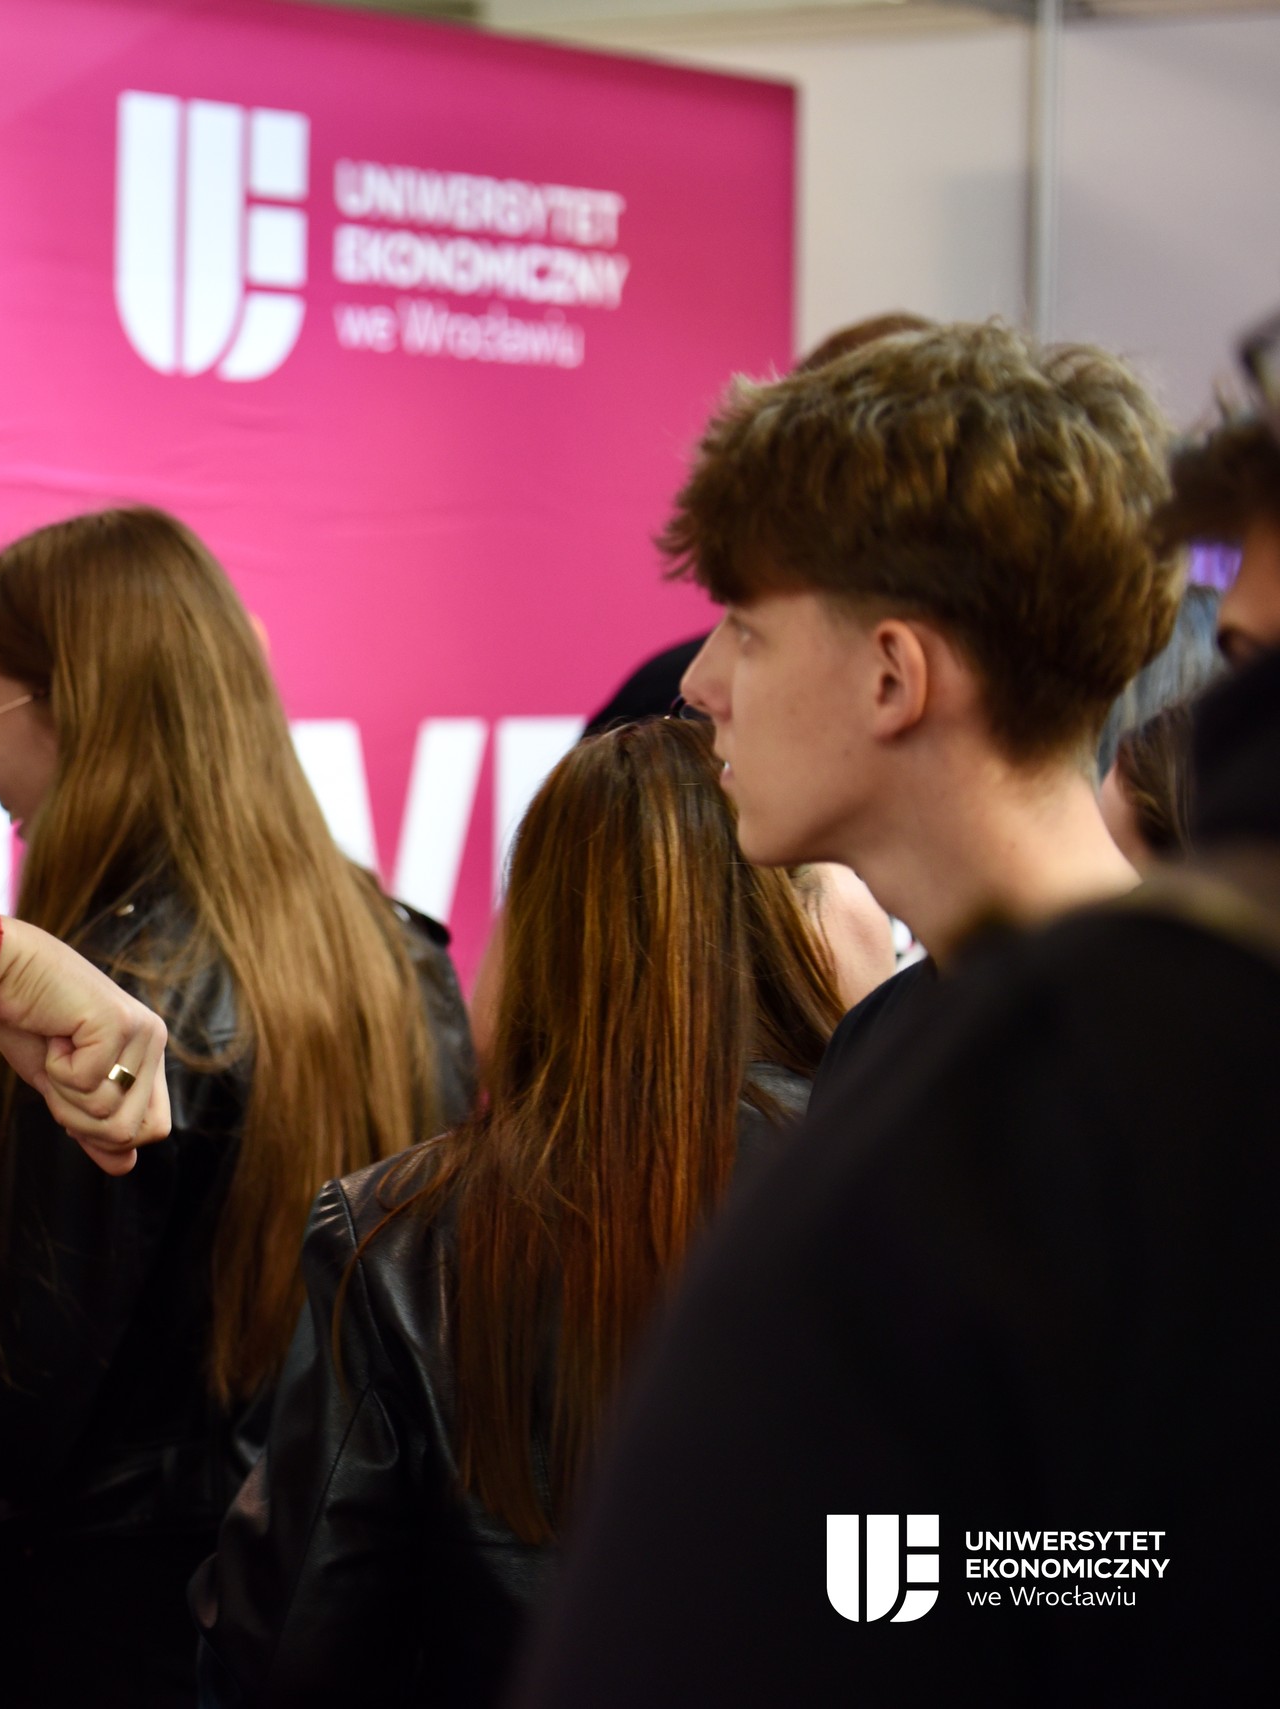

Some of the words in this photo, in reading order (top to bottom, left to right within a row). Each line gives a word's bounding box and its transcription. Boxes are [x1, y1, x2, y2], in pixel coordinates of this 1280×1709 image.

[334, 159, 625, 248] UNIWERSYTET
[333, 222, 629, 310] EKONOMICZNY
[333, 303, 396, 352] we
